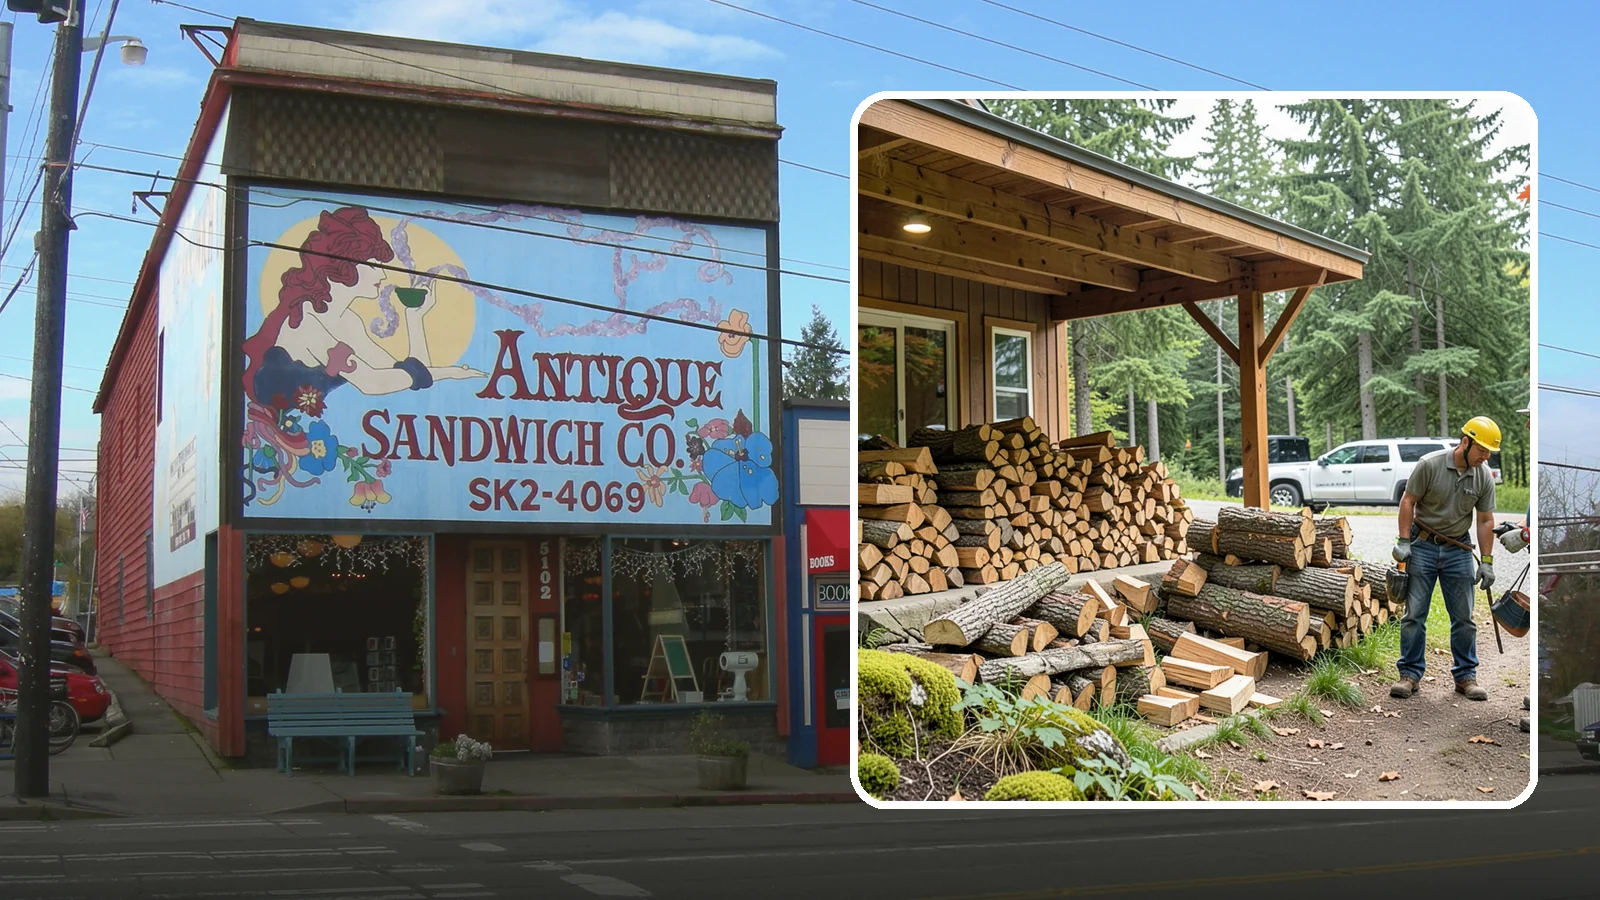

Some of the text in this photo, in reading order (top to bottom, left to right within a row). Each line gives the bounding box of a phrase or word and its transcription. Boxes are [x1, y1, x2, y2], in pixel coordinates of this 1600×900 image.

[475, 329, 724, 421] ANTIQUE
[361, 408, 685, 468] SANDWICH CO.
[468, 476, 646, 513] SK2-4069
[540, 542, 551, 599] 5102
[809, 555, 835, 569] BOOKS
